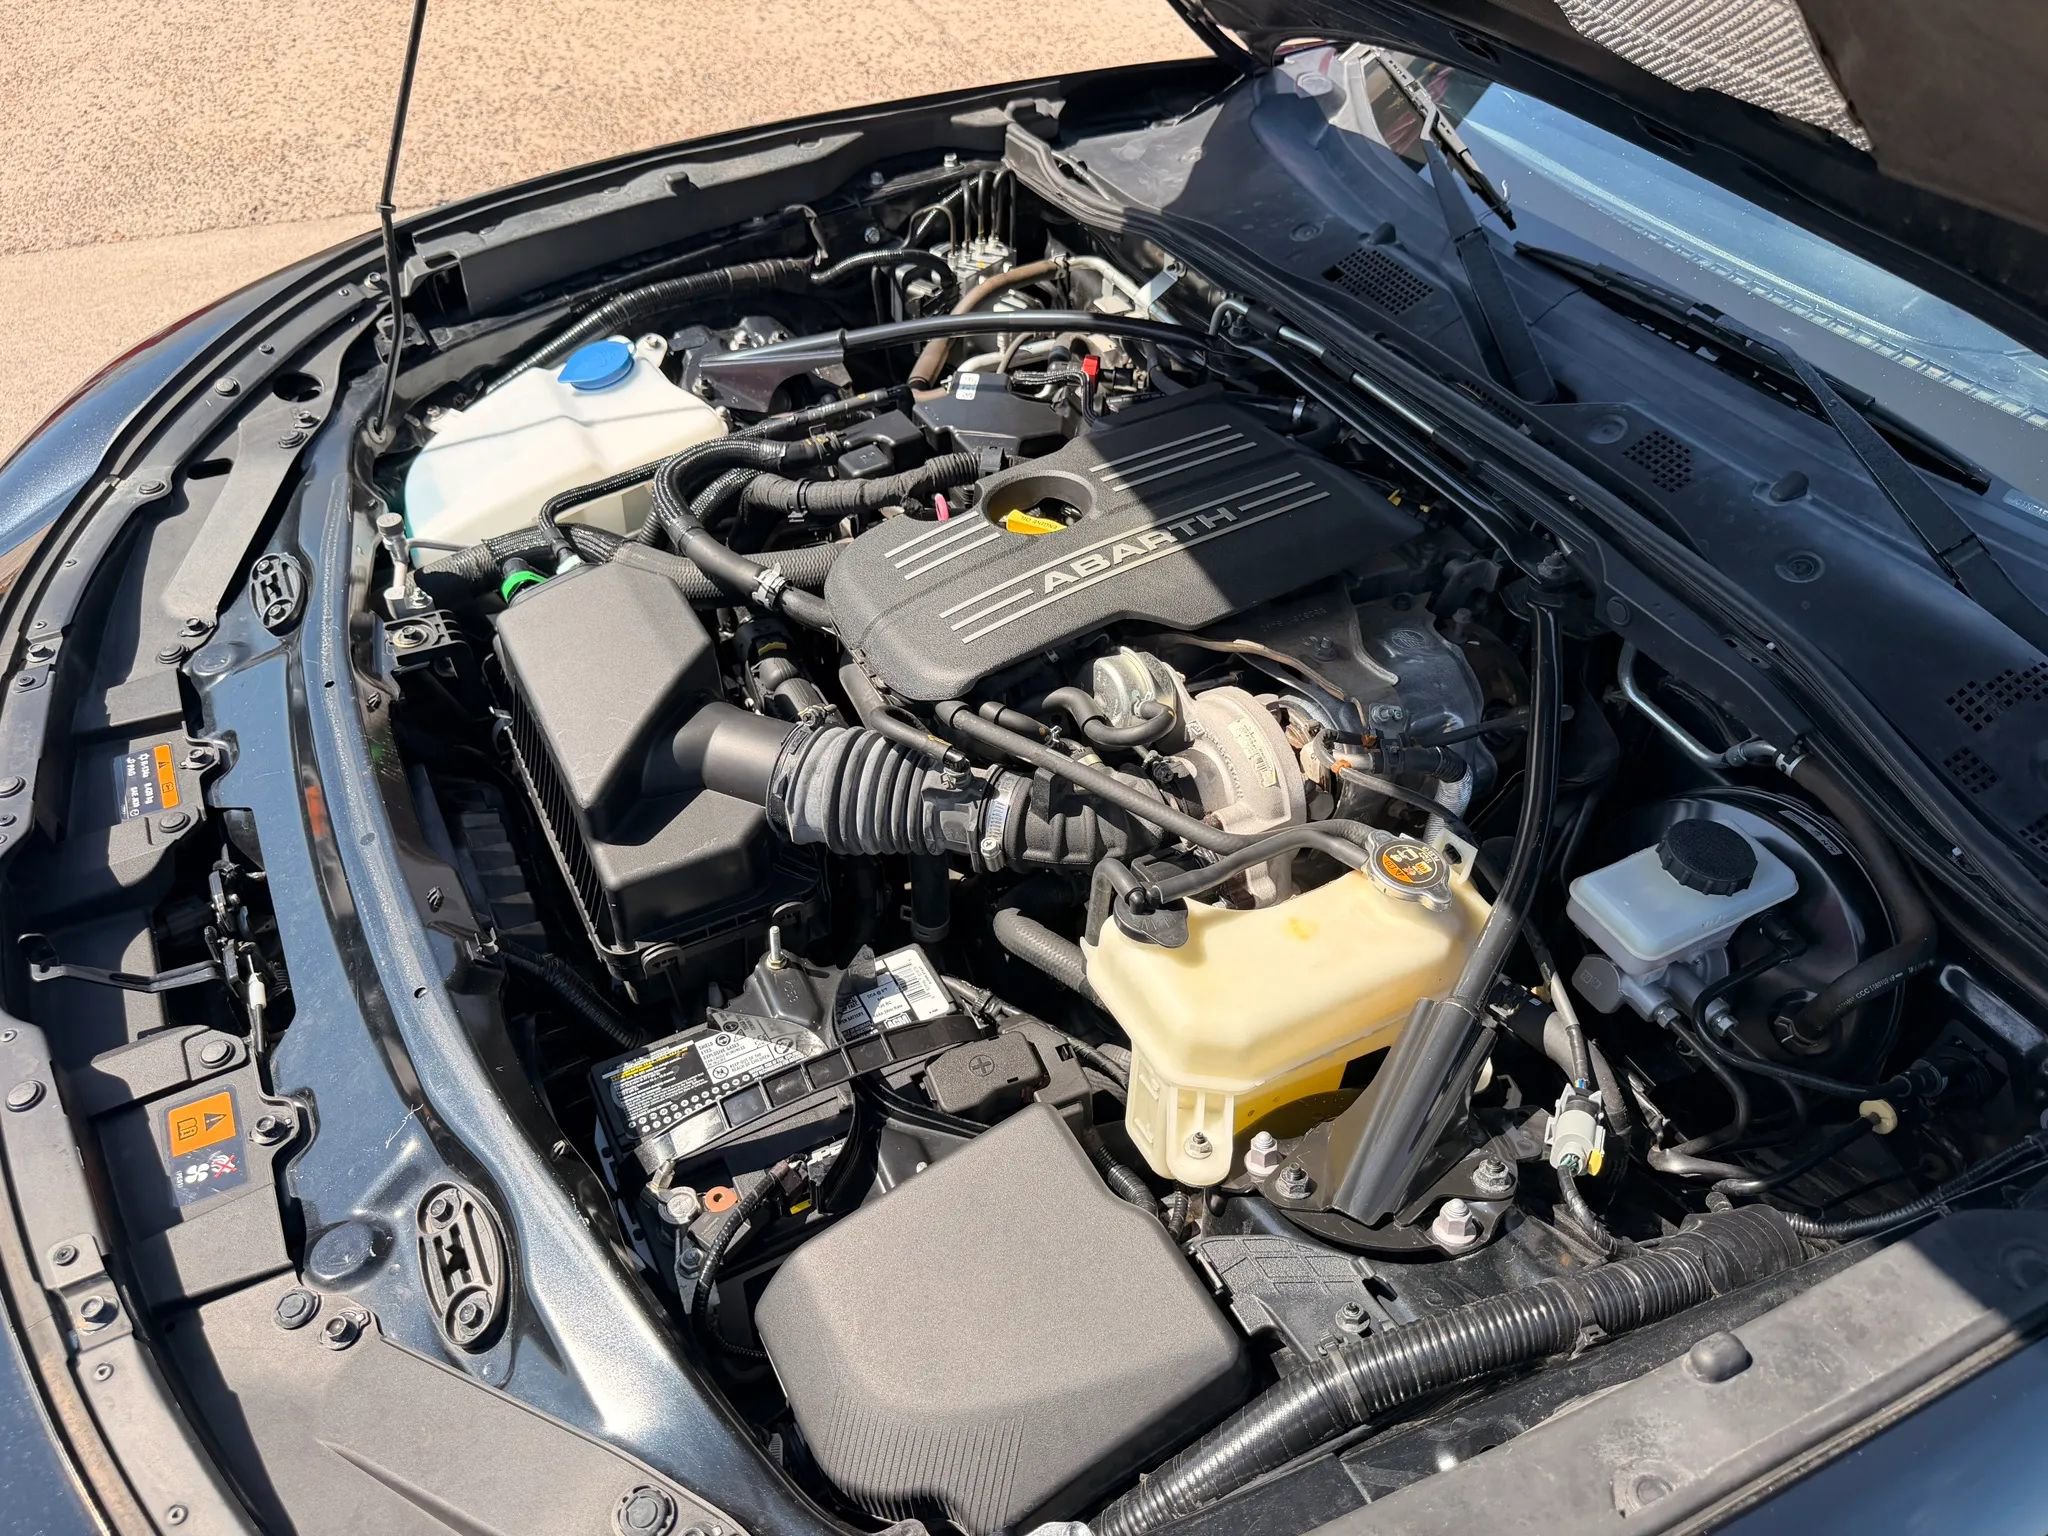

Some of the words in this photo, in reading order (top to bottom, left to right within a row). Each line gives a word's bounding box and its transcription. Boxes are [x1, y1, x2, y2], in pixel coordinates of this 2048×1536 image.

[1032, 520, 1058, 530] ENGINE
[1043, 506, 1238, 595] ABARTH
[1856, 987, 1870, 999] CCC
[886, 1015, 910, 1028] AGM
[698, 1041, 714, 1050] SHIELD
[703, 1049, 726, 1060] EXPLOSIVE
[726, 1043, 740, 1051] GASES
